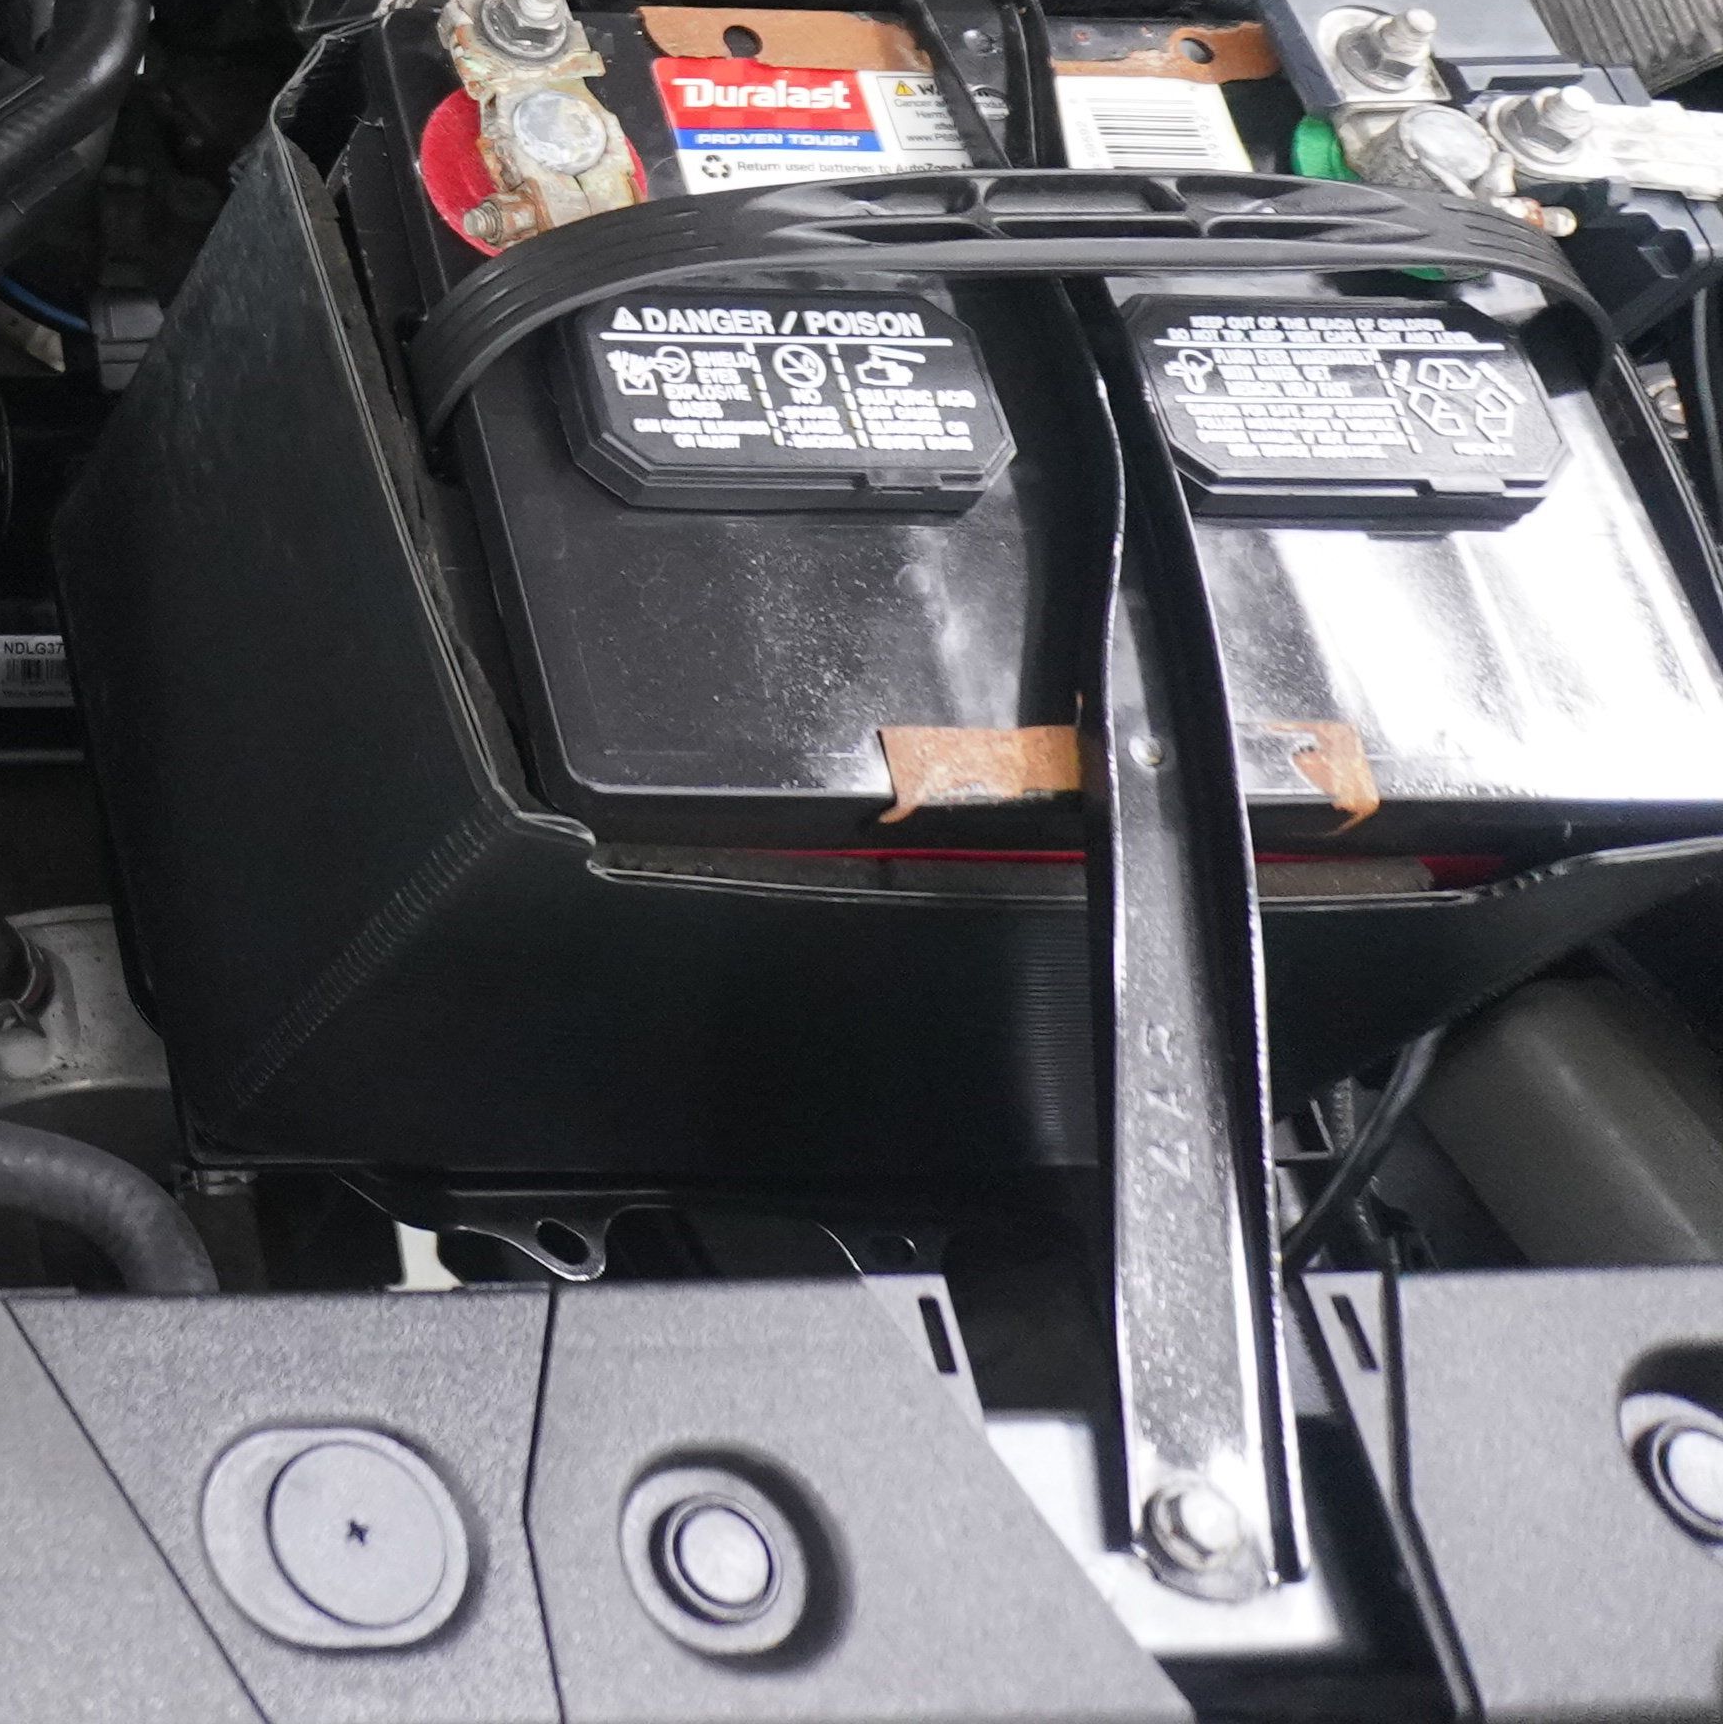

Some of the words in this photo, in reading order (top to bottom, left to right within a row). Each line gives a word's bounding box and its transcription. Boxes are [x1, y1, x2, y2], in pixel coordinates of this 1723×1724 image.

[671, 78, 851, 109] Duralast
[695, 133, 784, 146] PROVEN
[788, 134, 859, 147] TOUGH
[737, 161, 780, 172] Return
[786, 162, 815, 172] used
[819, 163, 874, 173] batteries
[879, 164, 891, 174] to
[641, 307, 775, 334] DANGER
[779, 310, 798, 335] /
[802, 309, 925, 337] POISON
[1189, 315, 1225, 328] KEEP
[1226, 316, 1255, 329] OUT
[1257, 316, 1277, 329] OF
[1278, 317, 1308, 330] THE
[1308, 317, 1355, 331] REACH
[1355, 318, 1377, 331] OF
[1168, 328, 1191, 341] DO
[1191, 328, 1219, 342] NOT
[1249, 329, 1285, 343] KEEP
[1403, 331, 1435, 344] AND
[691, 350, 752, 368] SHIELD
[695, 368, 741, 384] EYES
[662, 383, 752, 401] EXPLOSIVE
[790, 388, 822, 405] NO
[668, 401, 724, 418] GASES
